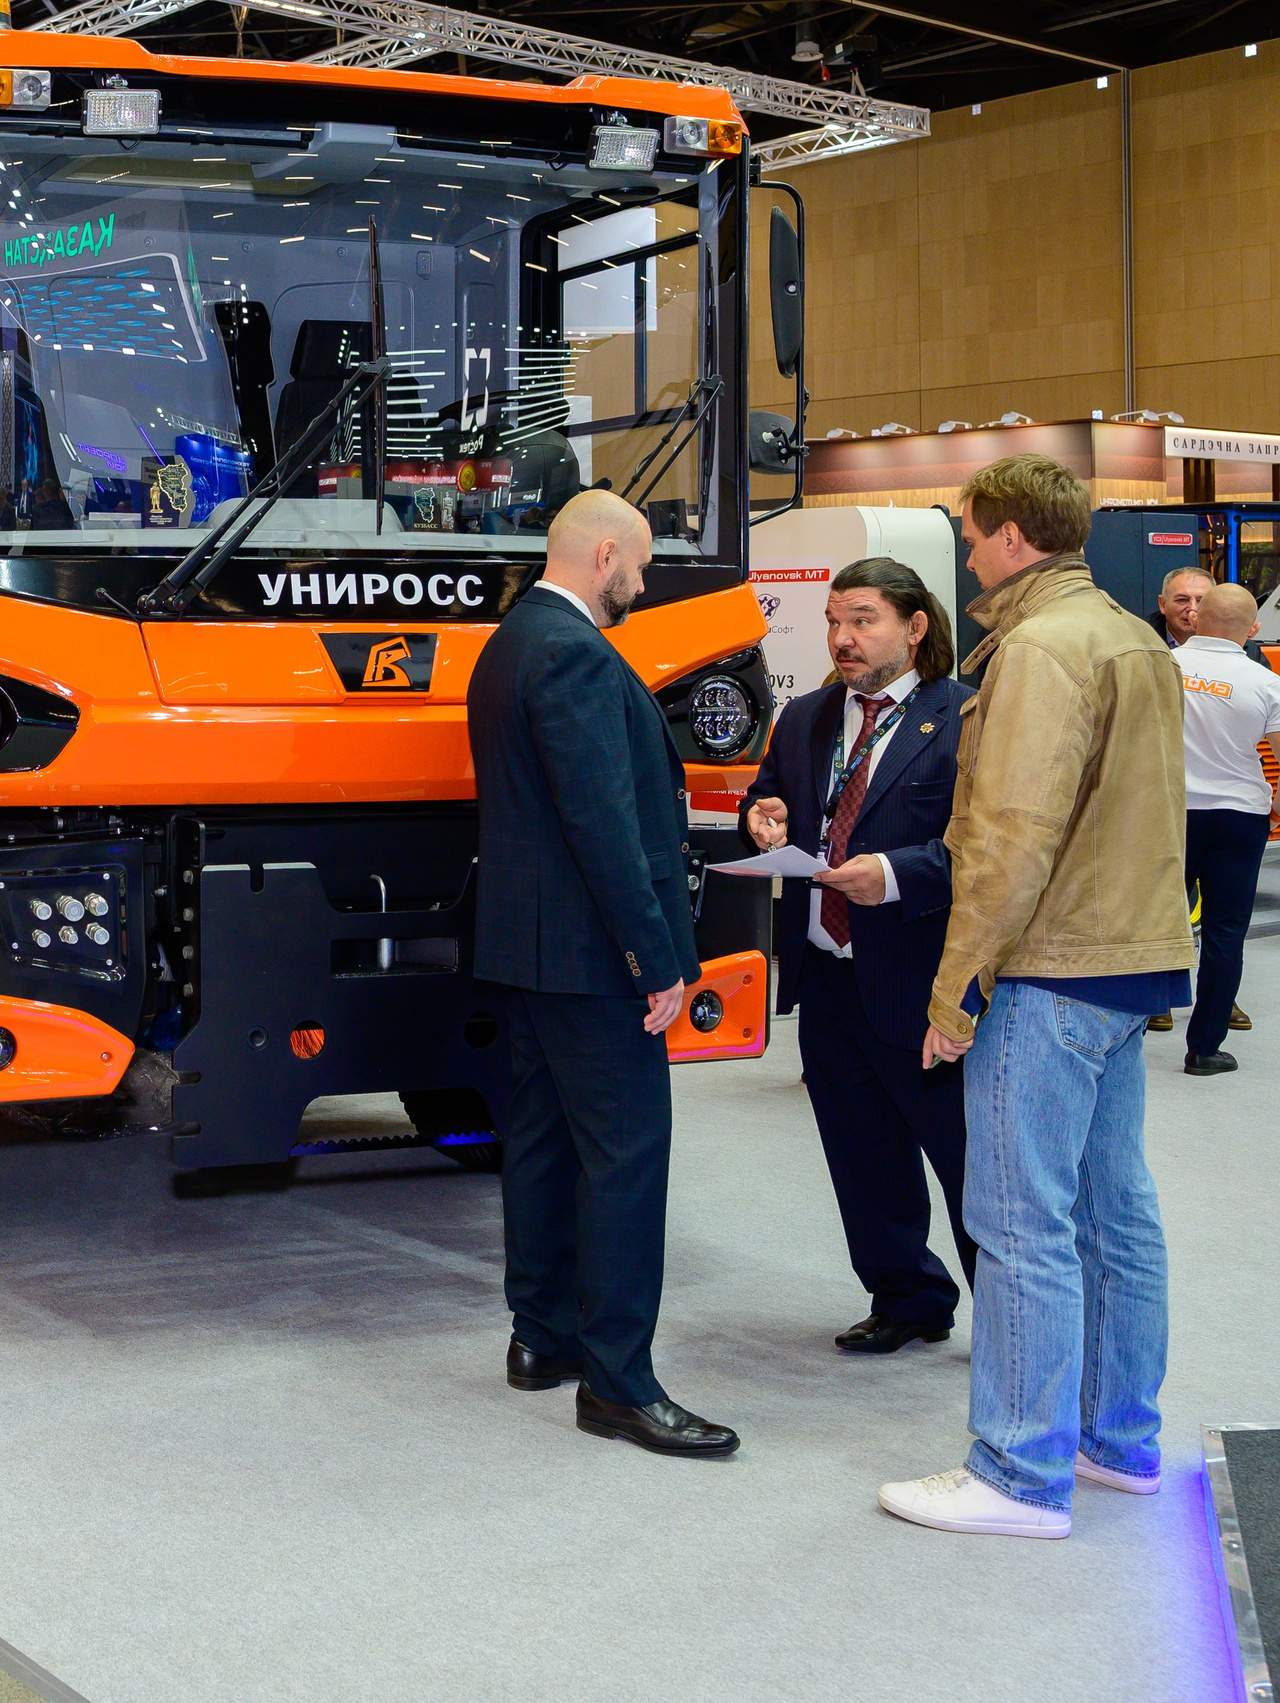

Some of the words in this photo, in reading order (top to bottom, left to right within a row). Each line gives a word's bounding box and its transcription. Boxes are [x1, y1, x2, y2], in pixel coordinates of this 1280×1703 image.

[1173, 438, 1241, 453] САРДЭЧНА
[805, 570, 825, 579] MT
[258, 573, 484, 606] УНИРОСС
